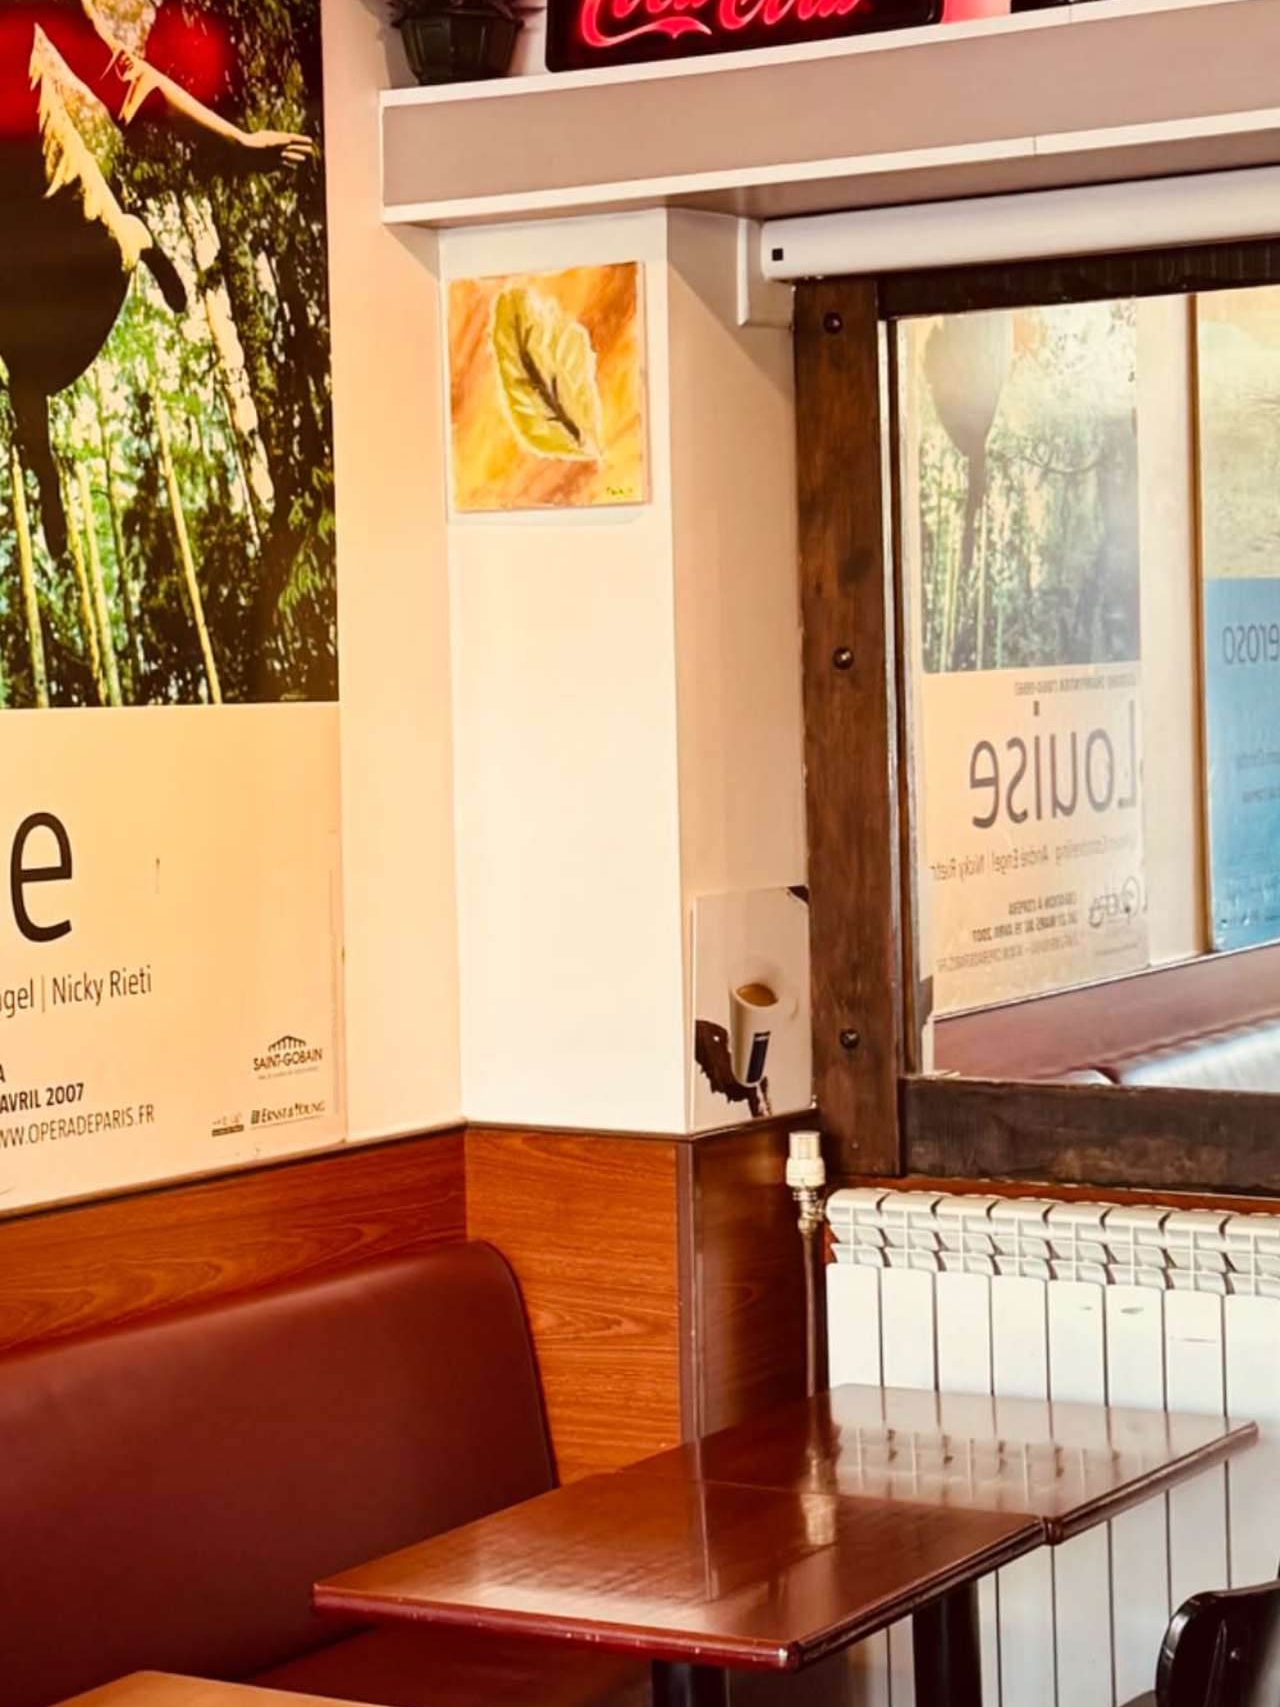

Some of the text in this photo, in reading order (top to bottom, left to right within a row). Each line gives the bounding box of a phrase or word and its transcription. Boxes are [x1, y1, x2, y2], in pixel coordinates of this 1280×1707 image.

[52, 973, 103, 1008] Nicky
[109, 965, 152, 997] Rieti
[253, 1048, 323, 1071] SAINT-GOBAIN
[0, 1089, 41, 1115] AVRIL
[46, 1082, 85, 1107] 2007
